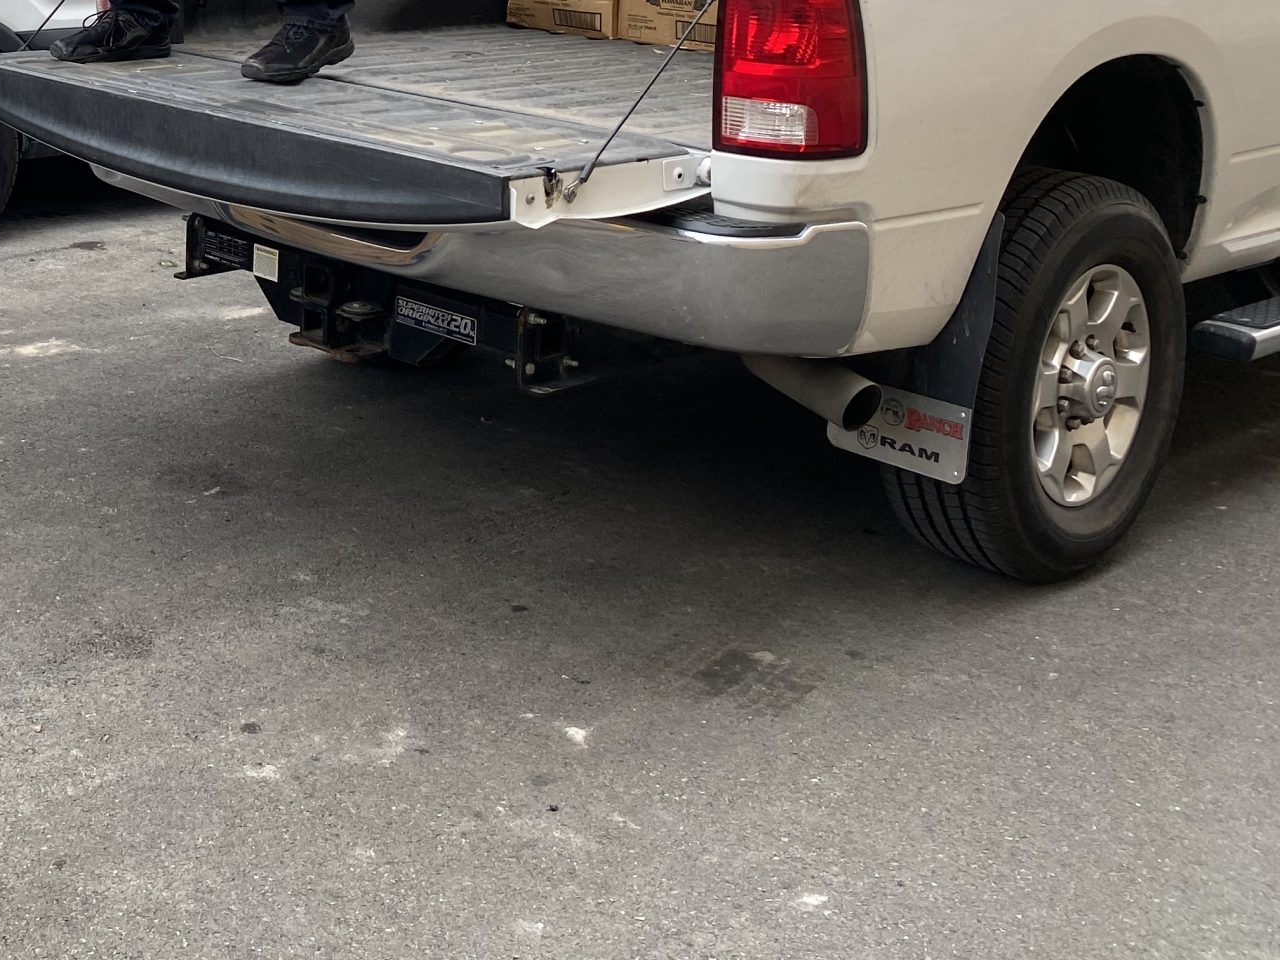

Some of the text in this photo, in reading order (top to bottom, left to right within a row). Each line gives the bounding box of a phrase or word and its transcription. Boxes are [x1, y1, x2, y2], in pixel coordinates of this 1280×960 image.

[398, 299, 451, 320] SUPERHITCH
[398, 307, 450, 329] ORIGINAL
[904, 406, 963, 440] RANCH
[880, 436, 940, 463] RAM
